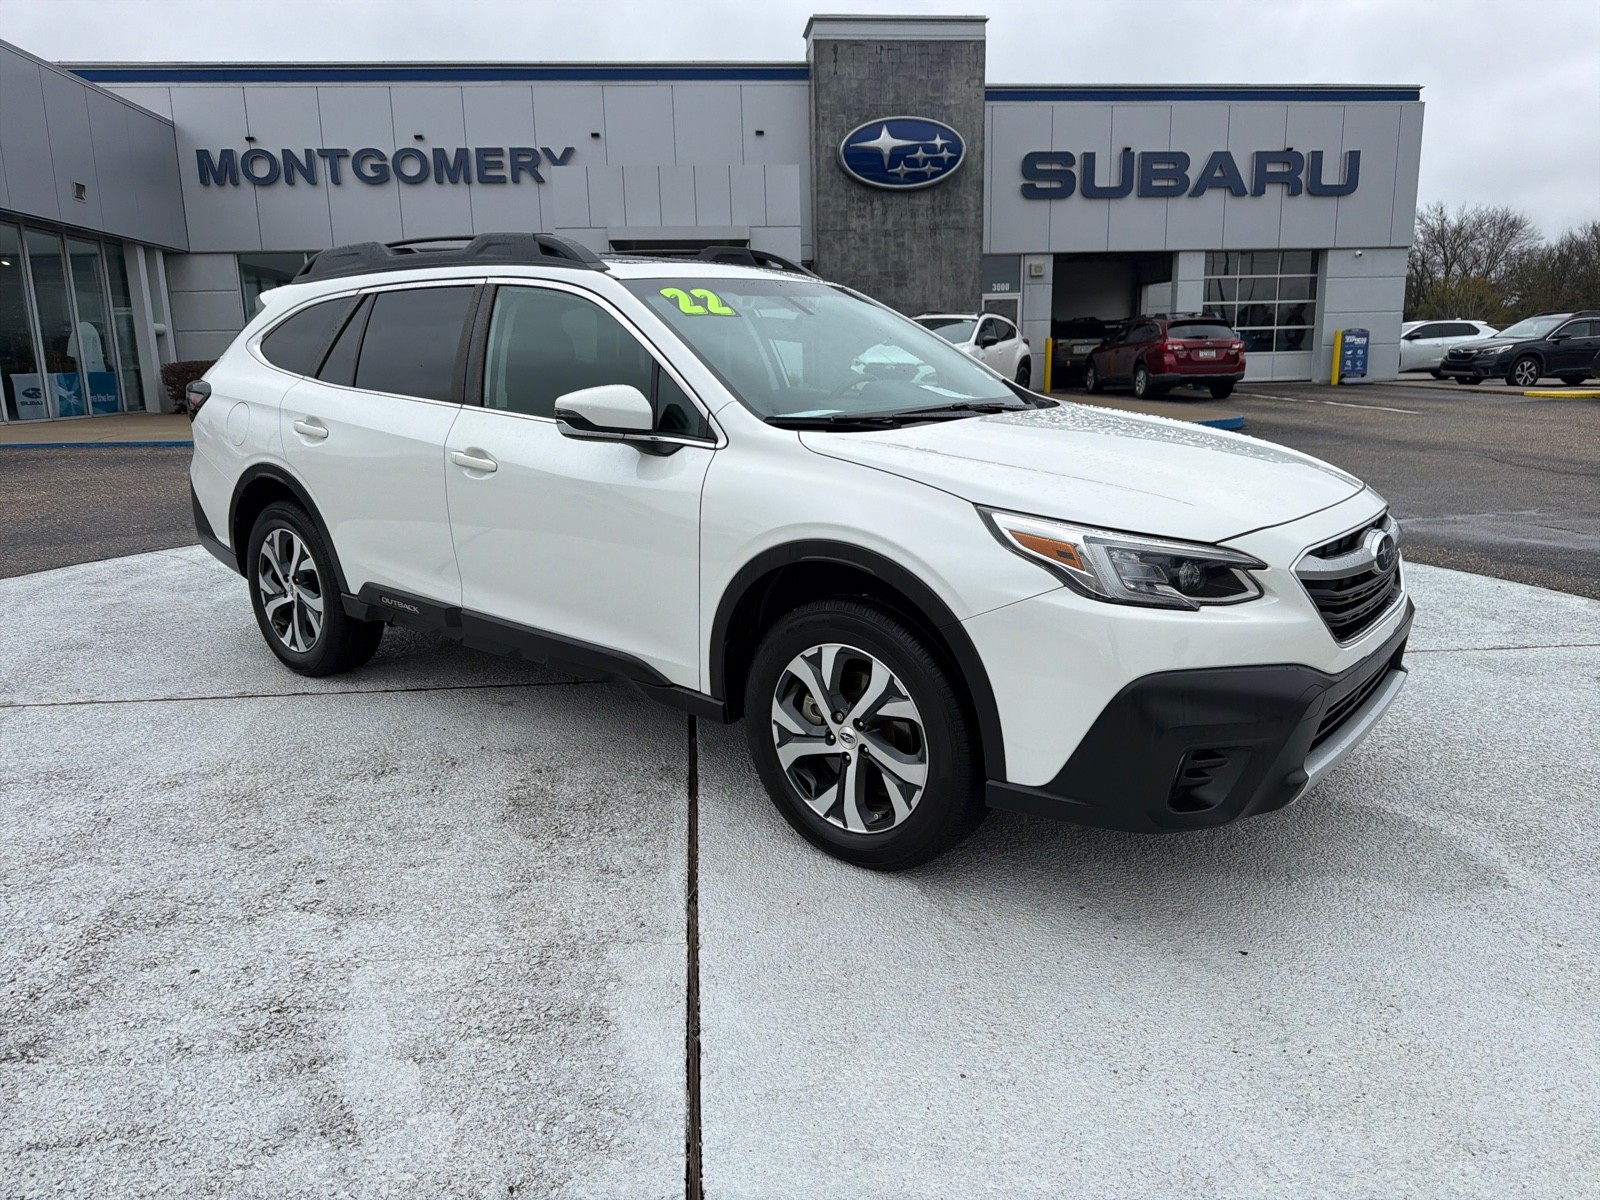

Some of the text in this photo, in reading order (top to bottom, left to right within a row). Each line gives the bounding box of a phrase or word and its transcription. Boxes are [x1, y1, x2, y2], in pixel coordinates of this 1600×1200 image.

[1021, 150, 1361, 199] SUBARU
[992, 282, 1010, 291] 3000
[660, 287, 736, 316] 22
[381, 596, 420, 614] OUTBACK
